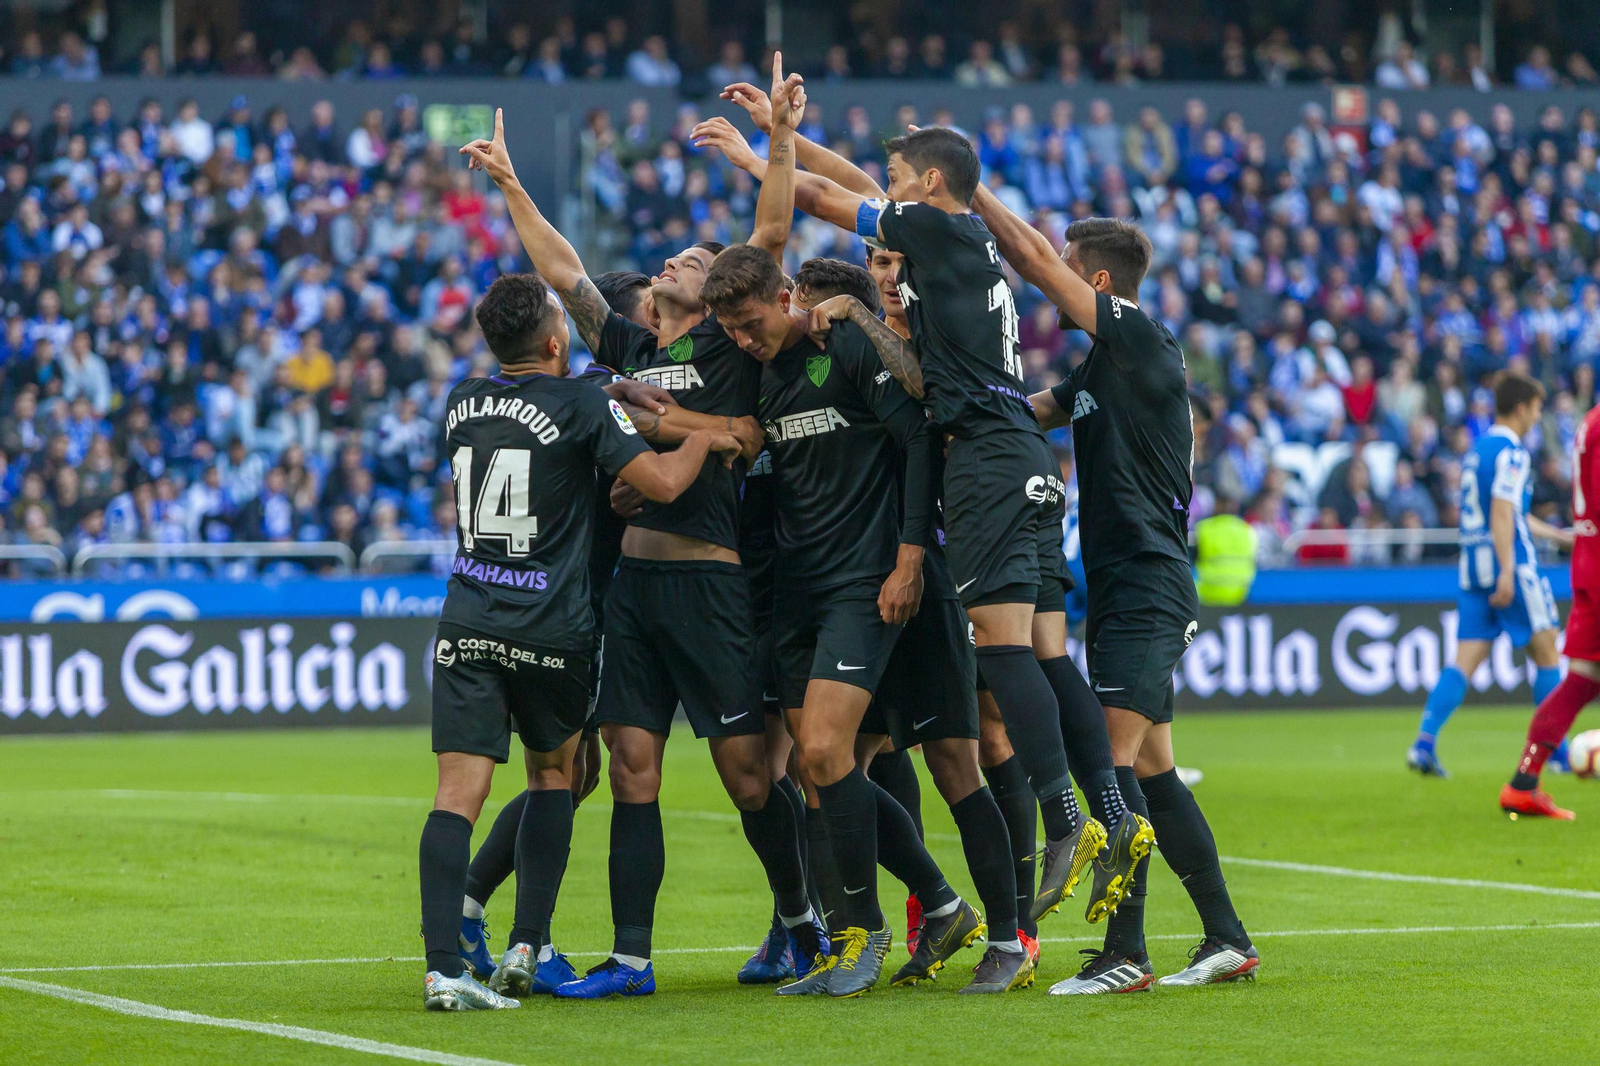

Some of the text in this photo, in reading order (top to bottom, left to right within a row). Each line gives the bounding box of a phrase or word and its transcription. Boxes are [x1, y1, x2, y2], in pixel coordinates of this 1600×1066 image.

[446, 395, 560, 445] OULAHROUD
[774, 406, 851, 441] TESESA
[452, 446, 538, 557] 14
[0, 632, 108, 719] lla
[120, 621, 410, 717] Galicia
[457, 638, 565, 670] COSTA DEL SOL
